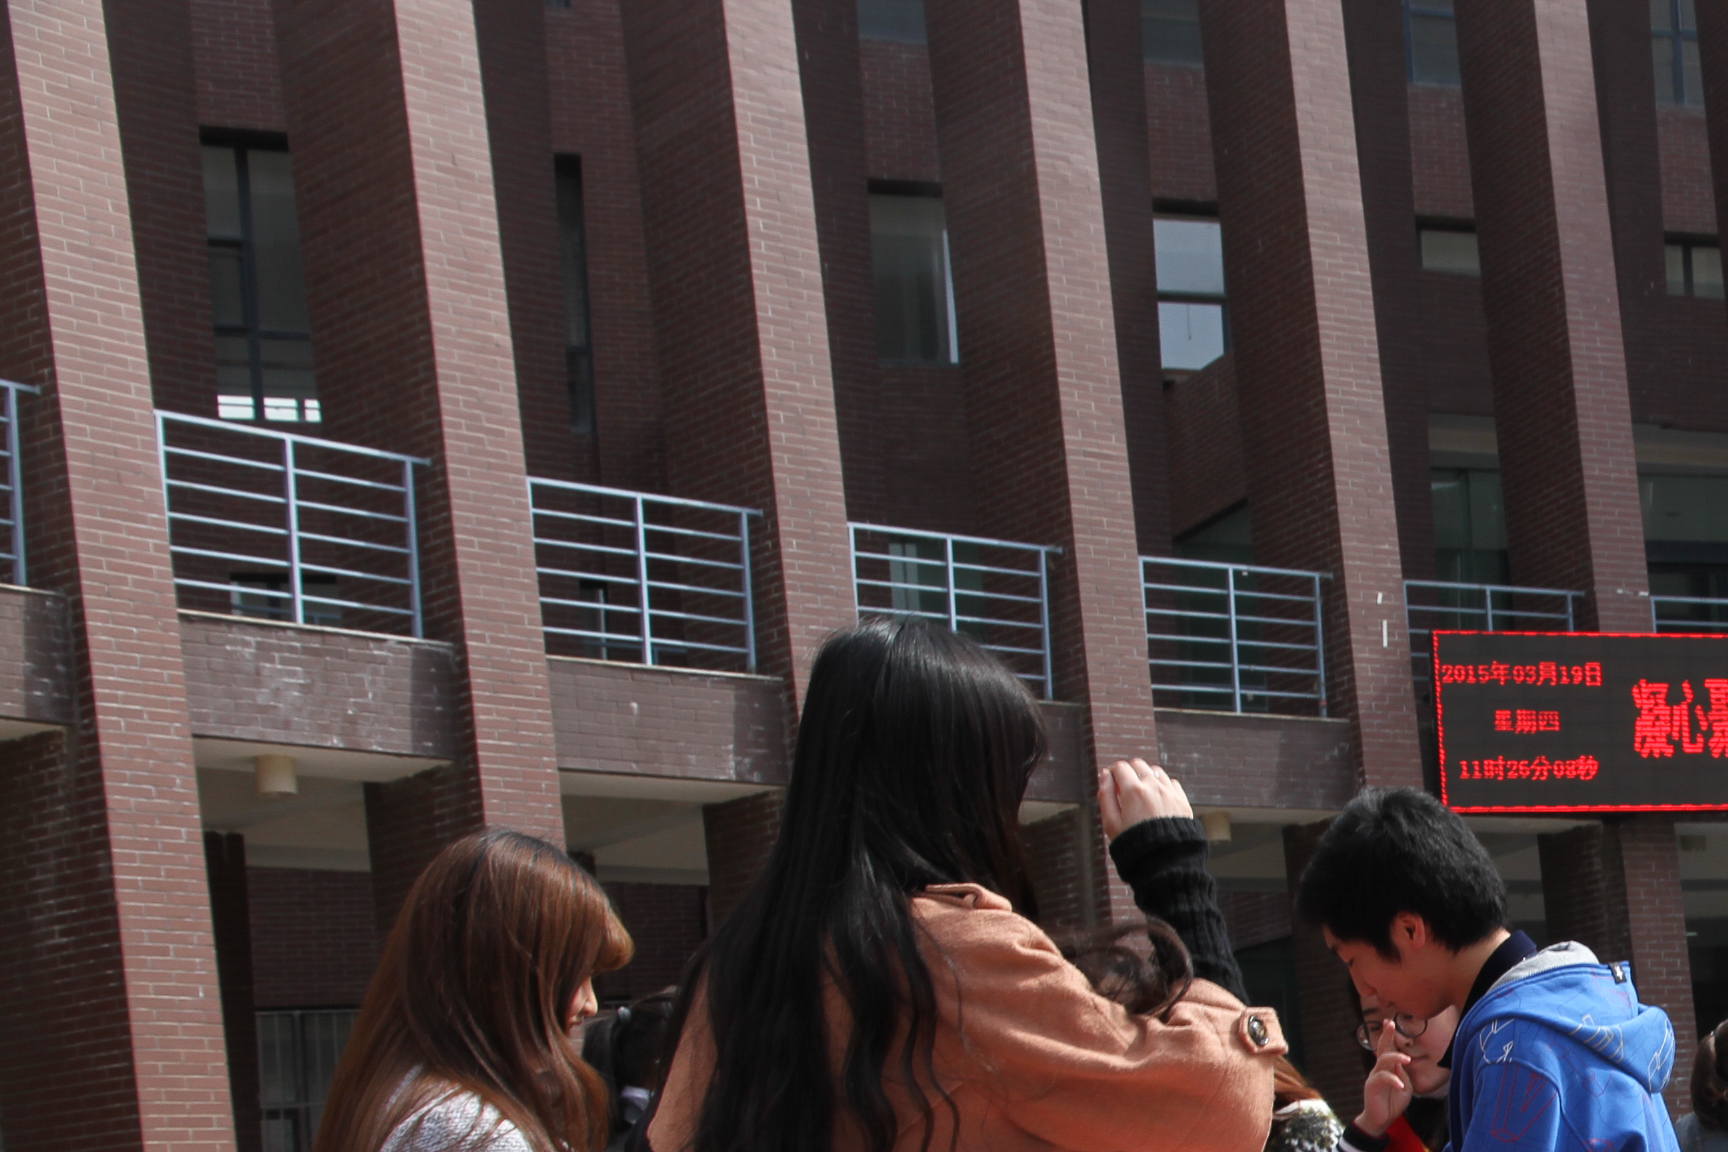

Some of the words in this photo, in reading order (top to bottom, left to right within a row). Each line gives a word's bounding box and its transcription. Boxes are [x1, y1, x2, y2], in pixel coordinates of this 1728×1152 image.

[1441, 661, 1603, 687] 2015年03月19日
[1494, 709, 1560, 734] 星期四
[1459, 755, 1600, 781] 11时26分08秒
